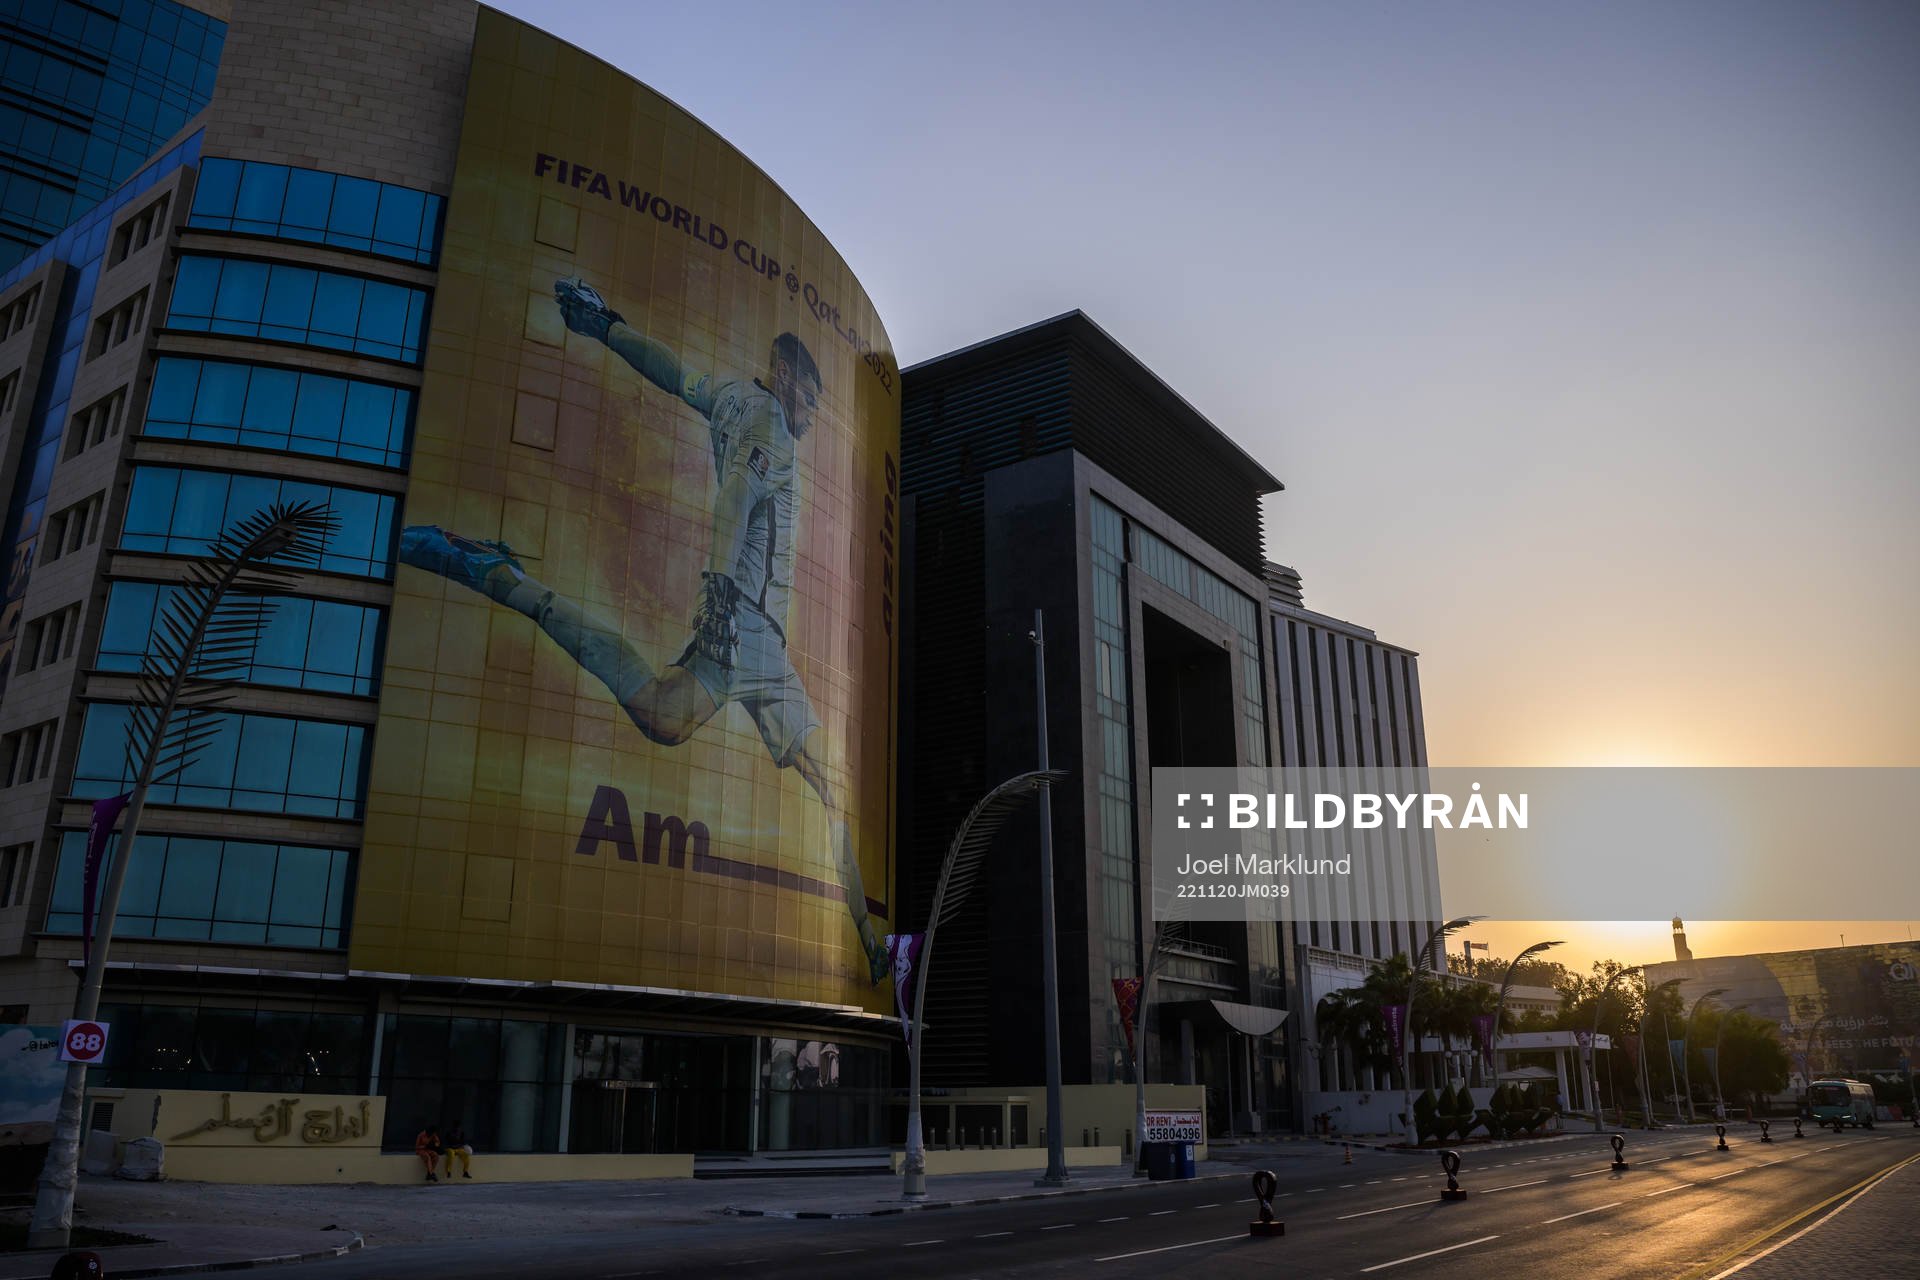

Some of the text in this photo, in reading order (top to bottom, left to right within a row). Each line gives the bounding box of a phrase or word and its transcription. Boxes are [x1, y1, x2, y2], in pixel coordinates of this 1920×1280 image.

[534, 152, 612, 201] FIFA
[618, 180, 728, 251] WORLD
[734, 239, 781, 281] CUP
[70, 1032, 101, 1052] 88
[1146, 1116, 1155, 1126] OR
[1156, 1116, 1171, 1126] RENT
[1148, 1128, 1200, 1140] 55804396
